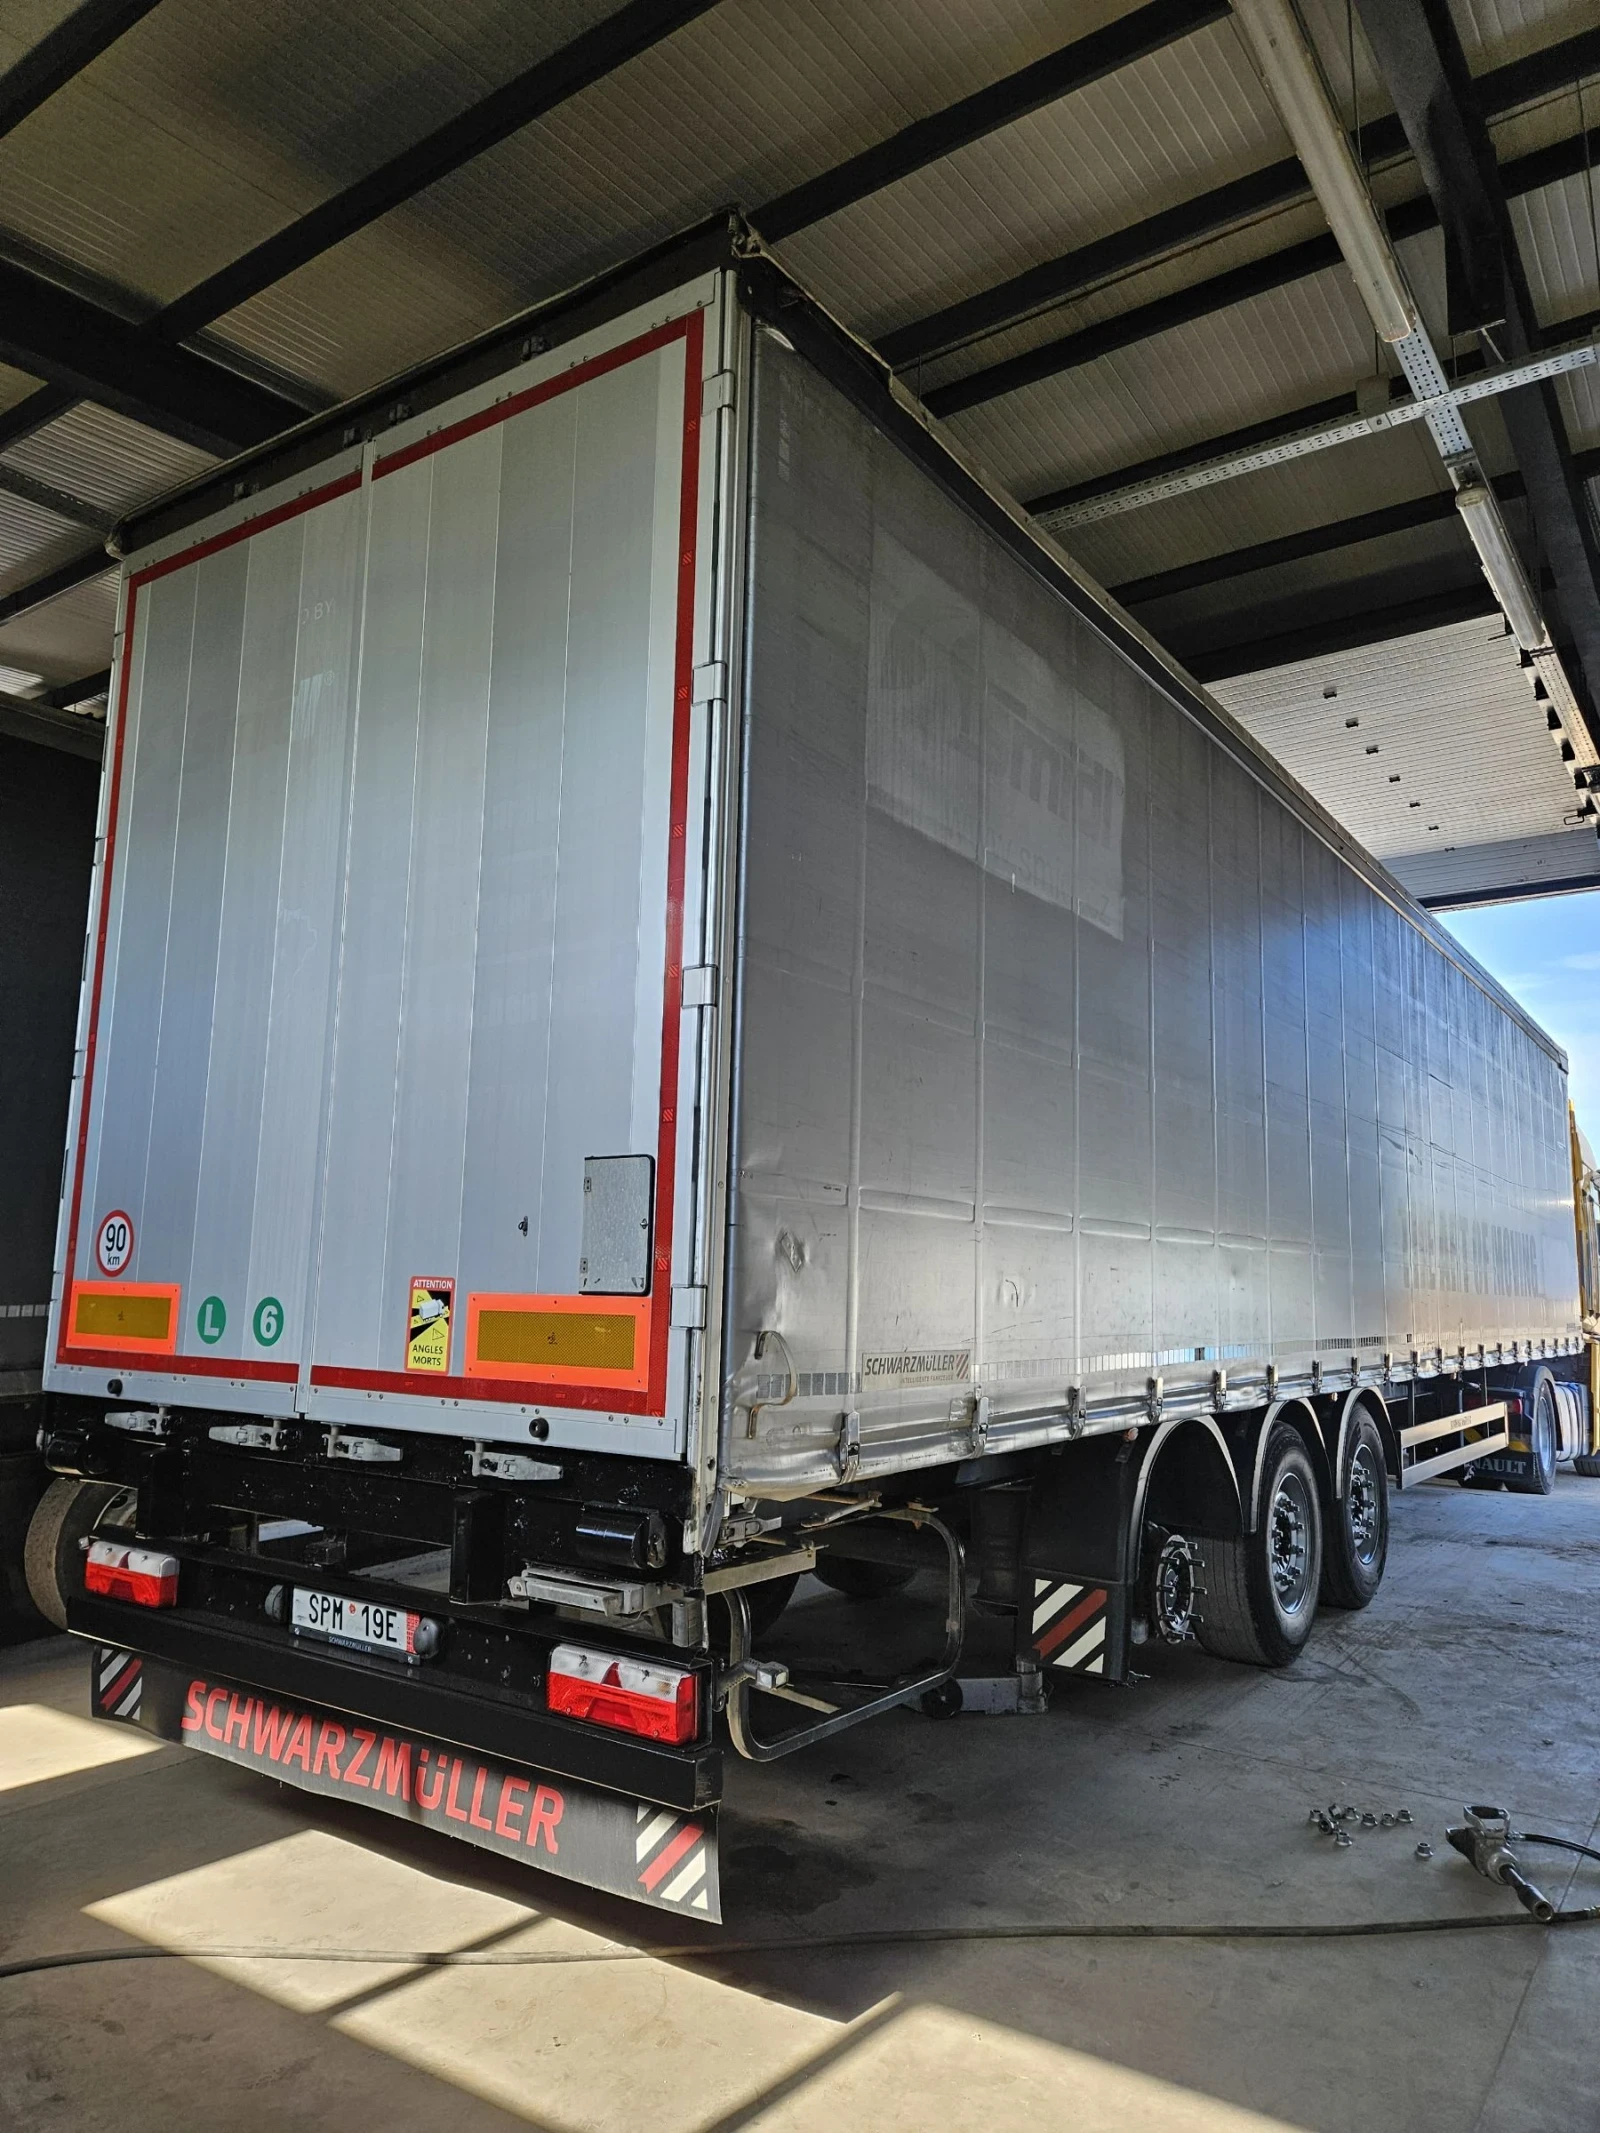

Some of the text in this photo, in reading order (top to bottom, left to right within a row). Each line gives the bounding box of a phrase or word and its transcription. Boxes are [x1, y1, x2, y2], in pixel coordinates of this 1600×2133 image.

[105, 1223, 127, 1252] 90
[107, 1253, 120, 1266] km
[413, 1279, 453, 1289] ATTENTION
[203, 1303, 220, 1337] L
[259, 1304, 279, 1339] 6
[412, 1344, 443, 1355] ANGLES
[412, 1356, 442, 1366] MORTS
[864, 1353, 955, 1376] SCHWARZMÜLLER
[308, 1593, 398, 1643] SPM 19E
[180, 1679, 565, 1856] SCHWARZMÜLLER
